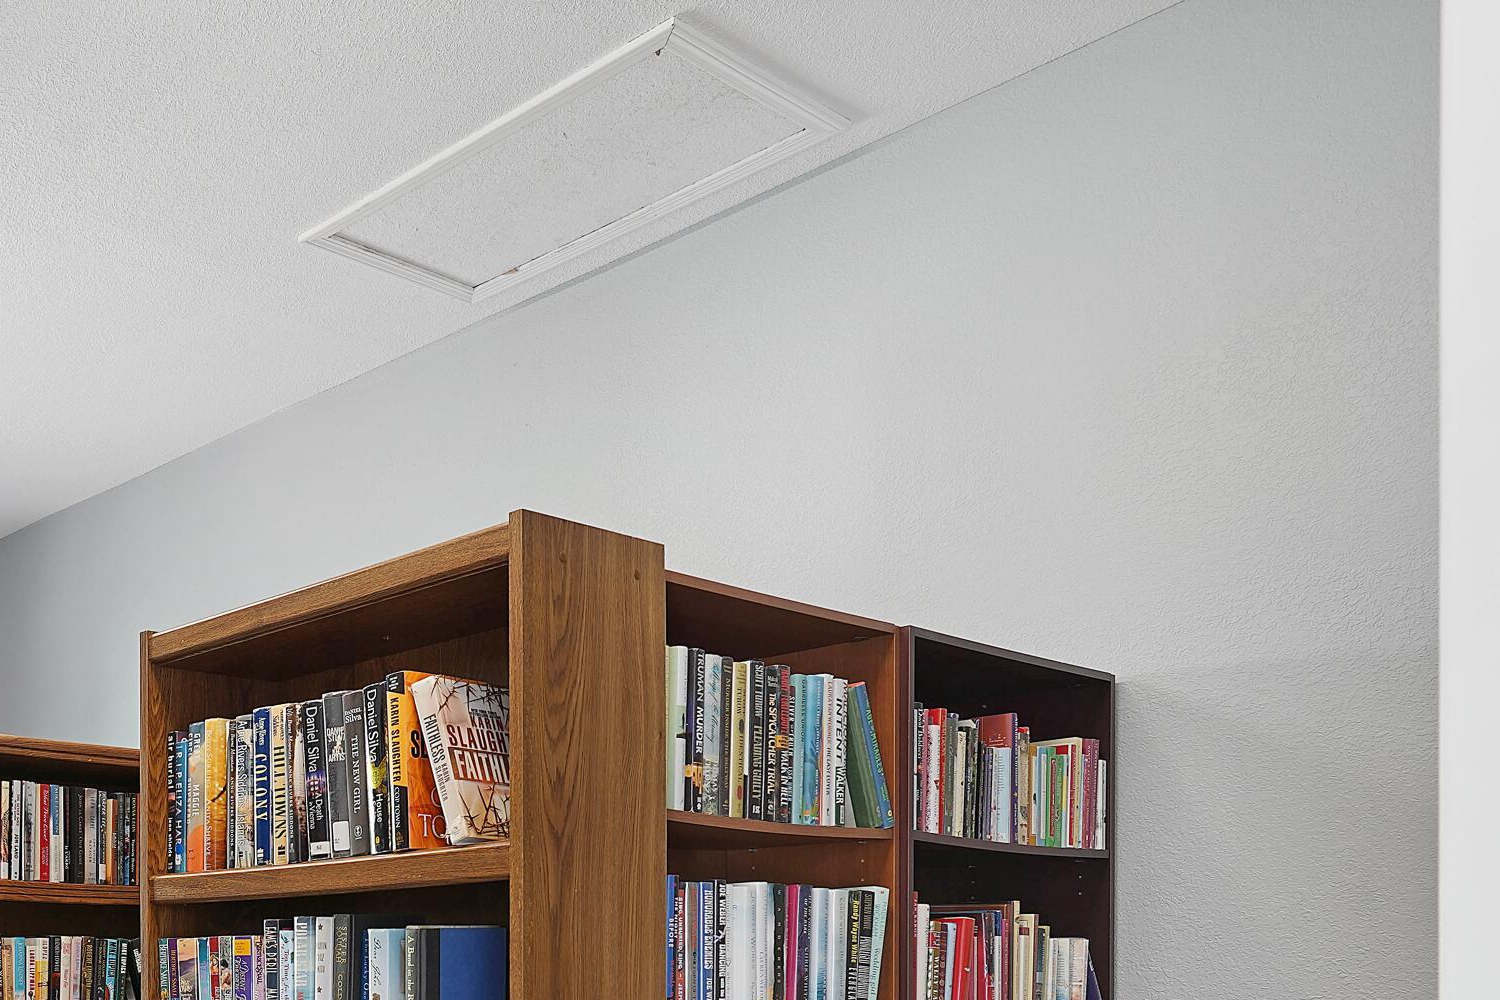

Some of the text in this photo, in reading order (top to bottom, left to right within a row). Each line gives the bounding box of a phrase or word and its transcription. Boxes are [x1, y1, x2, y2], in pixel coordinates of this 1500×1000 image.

[237, 721, 247, 743] Anne
[306, 706, 318, 773] Daniel Silva
[366, 689, 377, 762] Daniel Silva
[390, 697, 401, 783] KARIN SLAUGHTER
[423, 714, 445, 764] FAITHLESS
[447, 724, 509, 753] SLAUGH
[696, 706, 704, 753] MURDER
[768, 707, 777, 765] SPYCATCHER
[237, 745, 246, 771] Rivers
[351, 735, 361, 813] THE NEW GIRL
[780, 750, 789, 806] WALK IN HELL
[192, 784, 200, 816] MAGGIE
[237, 774, 246, 808] Siddons
[255, 753, 268, 821] COLONY
[274, 746, 286, 839] HILL TOWNS
[768, 767, 776, 794] TRIAL
[836, 766, 844, 804] WALKER
[376, 794, 384, 823] House
[705, 890, 714, 934] HONORABLE
[852, 900, 860, 920] Randy
[705, 936, 714, 970] ENEMIES
[851, 944, 859, 963] White
